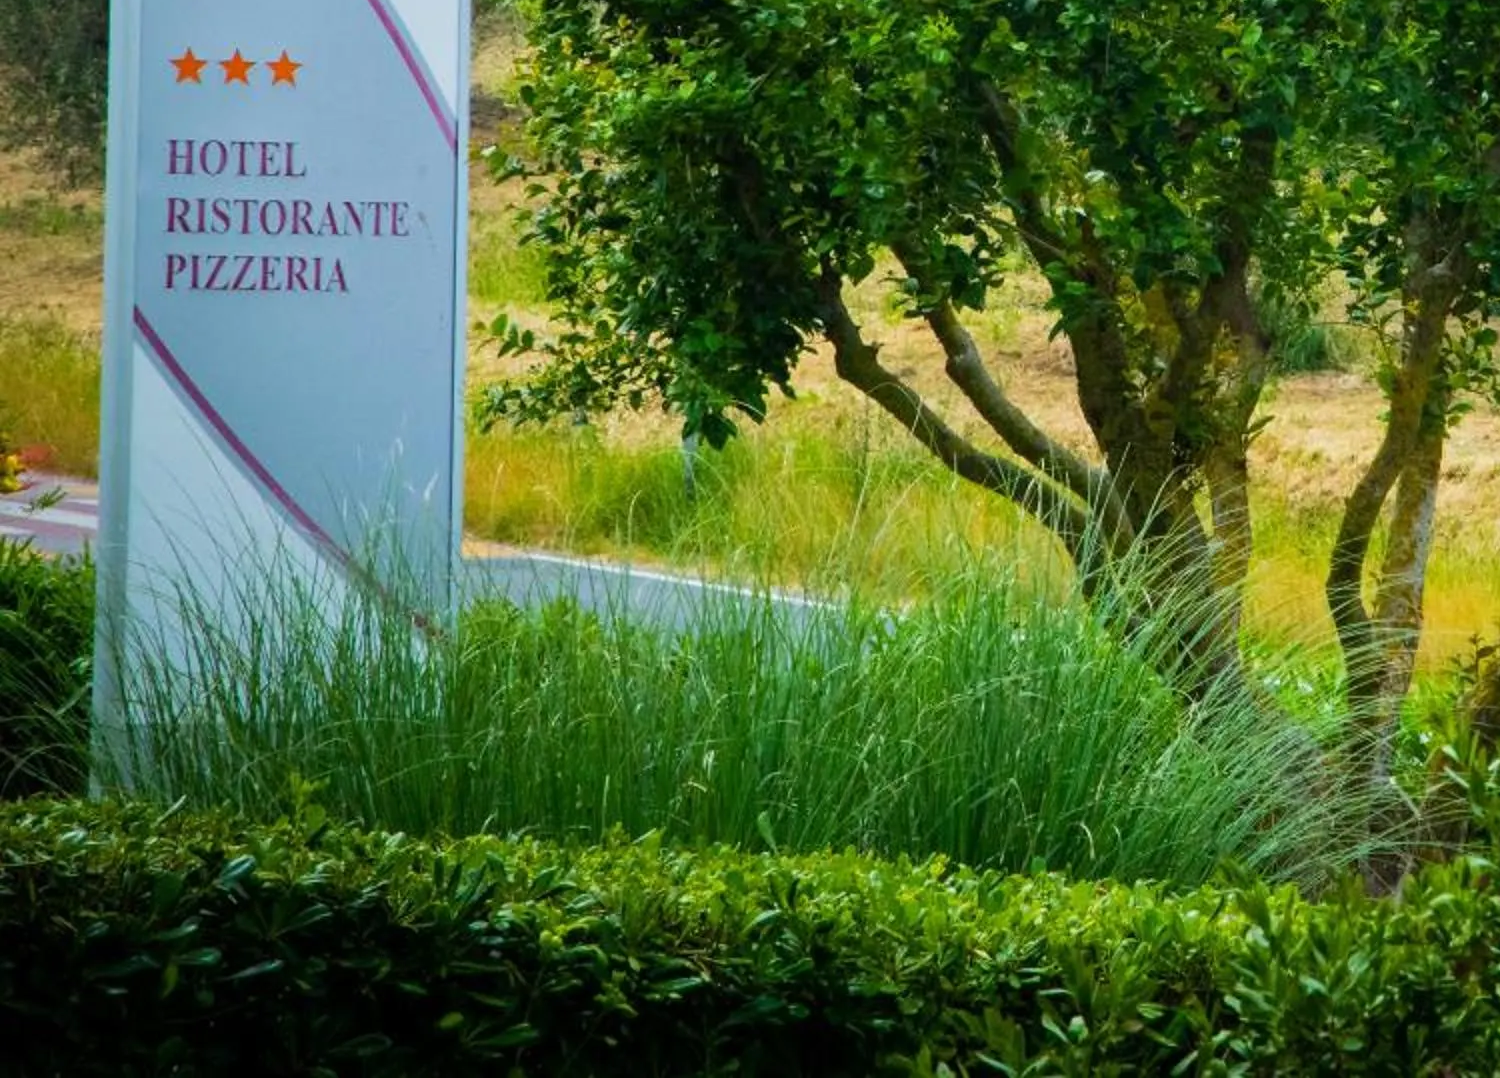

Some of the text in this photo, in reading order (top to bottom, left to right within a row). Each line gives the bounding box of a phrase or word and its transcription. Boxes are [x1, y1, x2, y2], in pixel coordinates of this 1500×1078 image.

[166, 139, 307, 178] HOTEL
[165, 197, 410, 237] RISTORANTE
[164, 253, 349, 293] PIZZERIA
